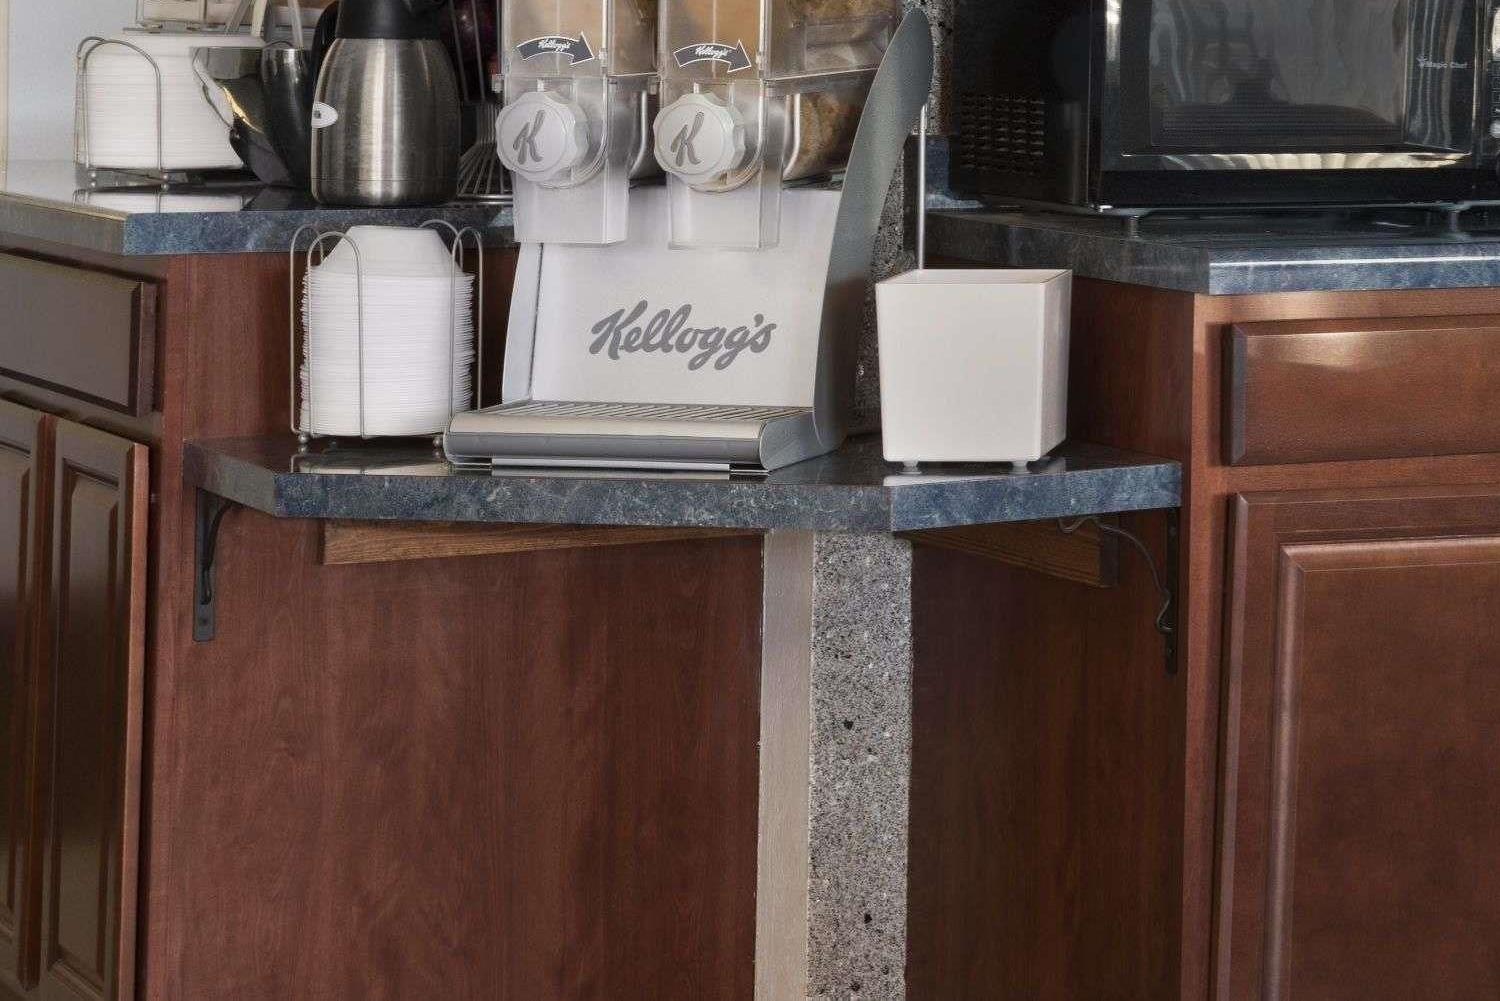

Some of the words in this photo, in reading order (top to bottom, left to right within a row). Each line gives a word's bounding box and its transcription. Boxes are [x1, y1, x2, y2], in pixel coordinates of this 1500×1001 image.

[513, 110, 546, 165] K
[671, 111, 705, 167] K
[588, 299, 777, 371] Kellogg's
